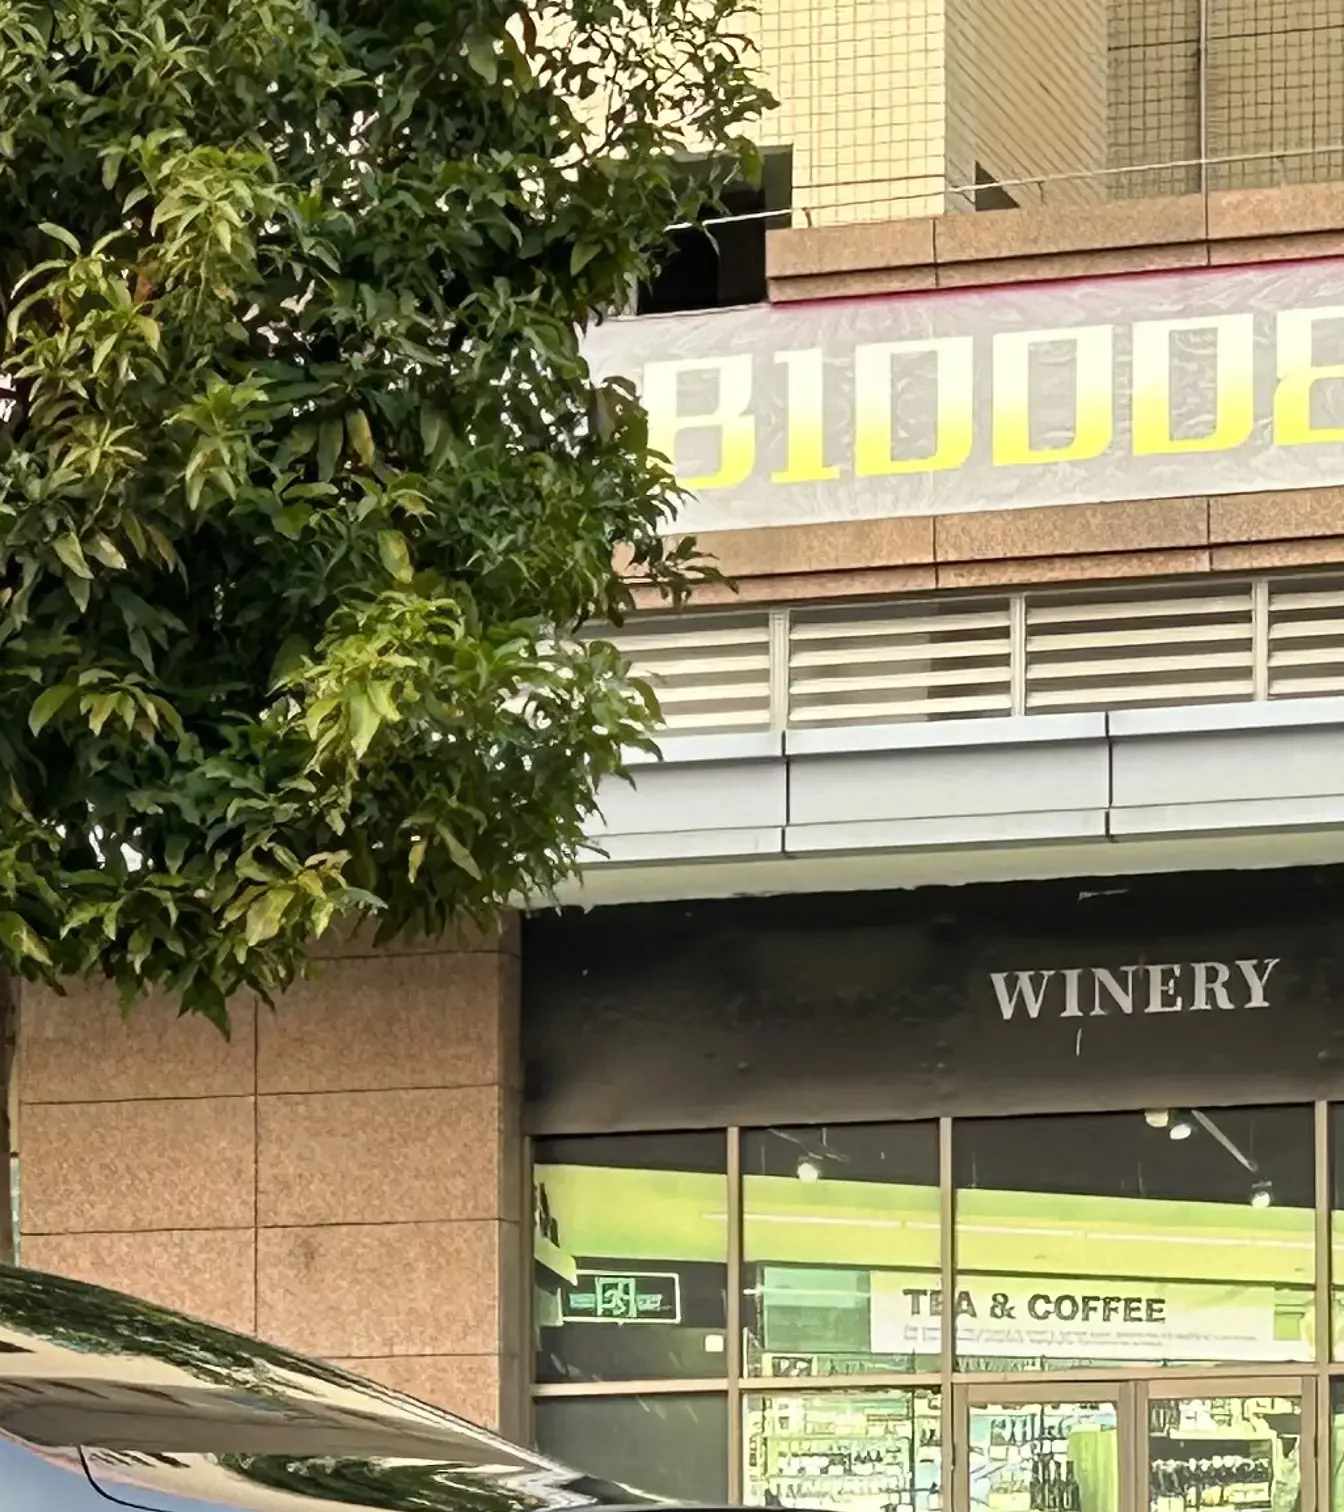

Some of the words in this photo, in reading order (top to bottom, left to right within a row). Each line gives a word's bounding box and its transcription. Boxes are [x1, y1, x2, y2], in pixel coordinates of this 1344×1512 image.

[989, 957, 1281, 1021] WINERY
[989, 1292, 1016, 1320] &
[1027, 1292, 1167, 1324] COFFEE
